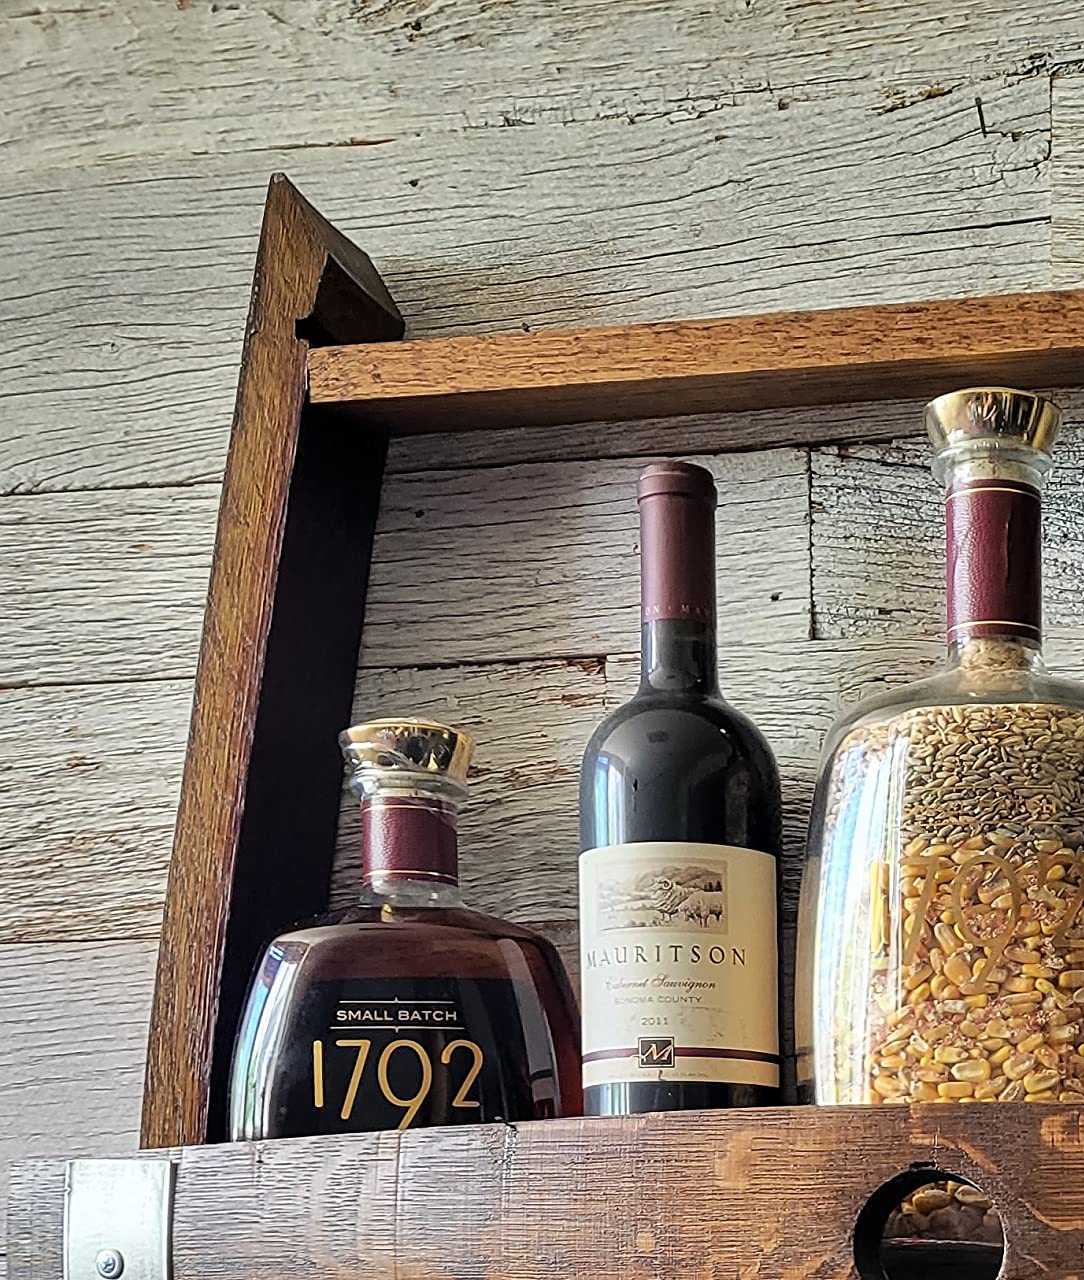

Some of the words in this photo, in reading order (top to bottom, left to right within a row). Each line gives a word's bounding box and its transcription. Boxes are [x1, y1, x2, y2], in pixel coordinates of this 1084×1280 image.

[586, 944, 746, 970] MAURITSON
[650, 973, 716, 993] Sauvignon
[657, 995, 703, 1004] COUNTY
[336, 1010, 394, 1022] SMALL
[398, 1010, 458, 1022] BATCH
[641, 1016, 669, 1026] 2011
[312, 1038, 485, 1130] 1792
